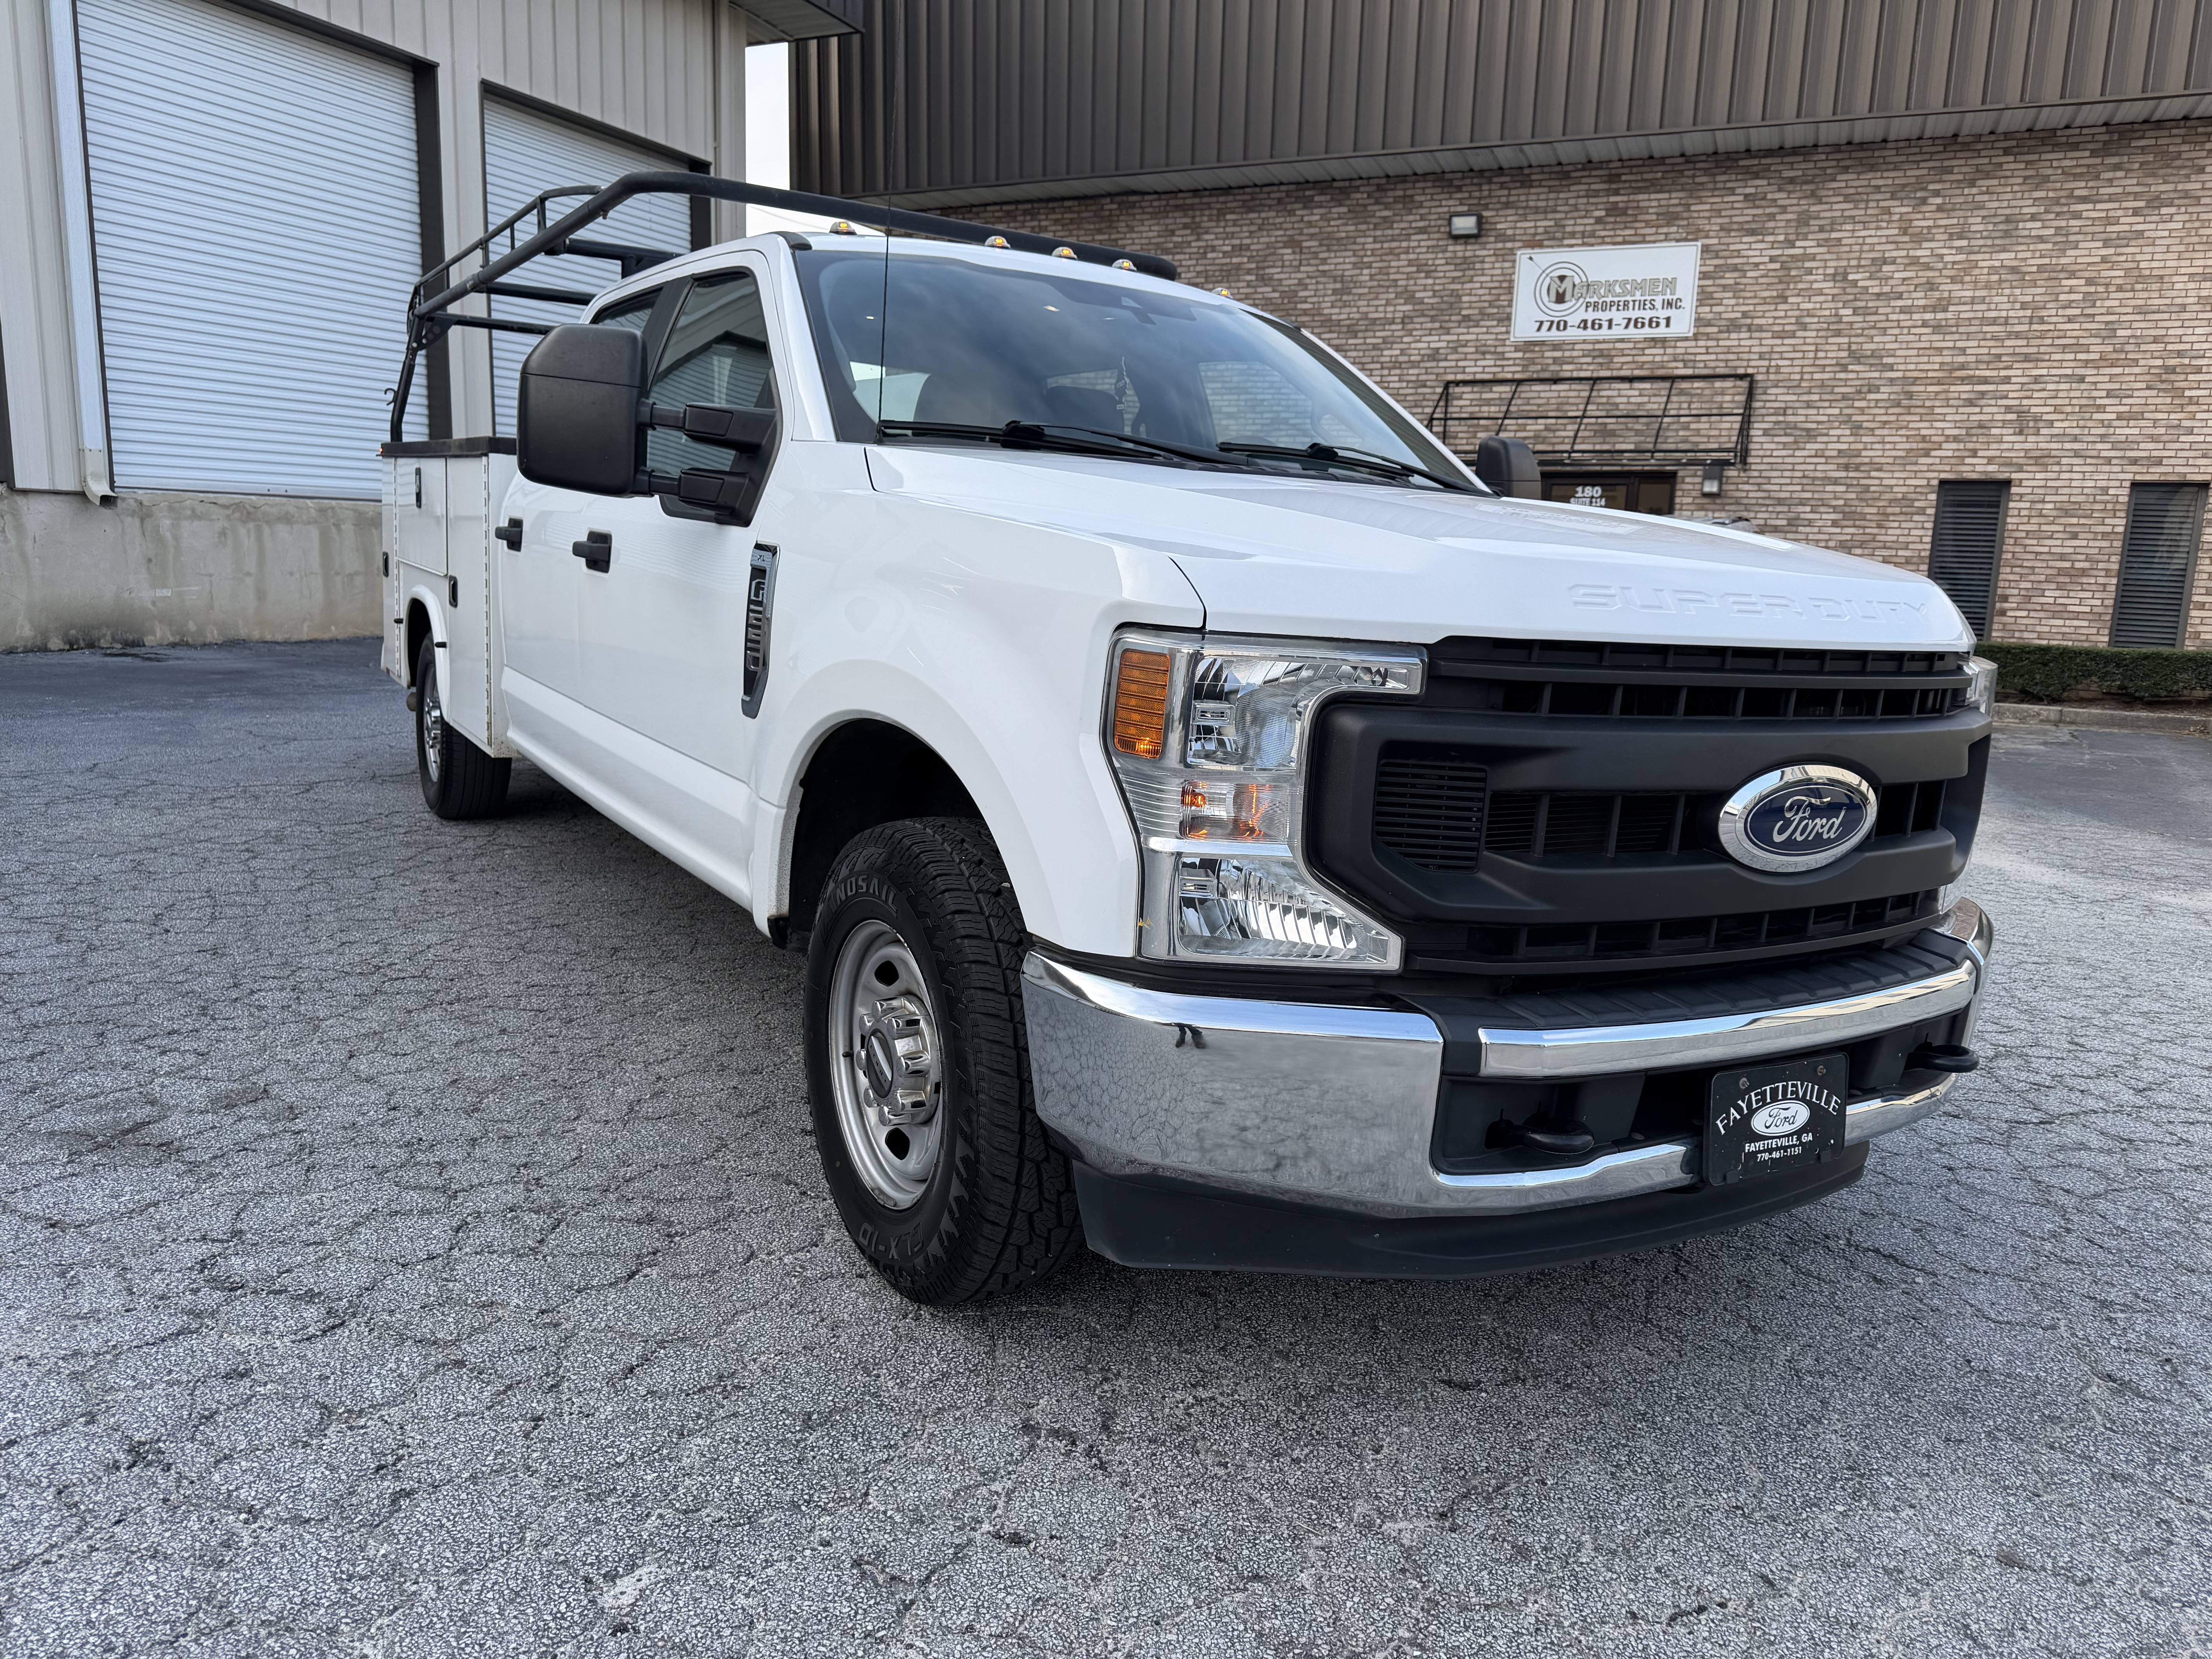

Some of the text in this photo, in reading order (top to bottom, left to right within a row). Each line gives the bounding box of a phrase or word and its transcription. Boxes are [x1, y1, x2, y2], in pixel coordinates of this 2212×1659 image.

[1585, 298, 1685, 313] PROPERTIES, INC.
[1534, 316, 1672, 332] 770-461-7661
[1575, 486, 1602, 497] 180
[1570, 497, 1606, 507] SUITE 114
[757, 554, 765, 562] XL
[1567, 583, 1929, 624] SUPER DUTY
[1772, 795, 1847, 843] Ford
[1716, 1081, 1841, 1135] FAYETTEVILLE
[1764, 1106, 1798, 1129] Ford
[1745, 1132, 1813, 1152] FAYETTEVILLE, GA
[1757, 1146, 1802, 1161] 770-461-1151
